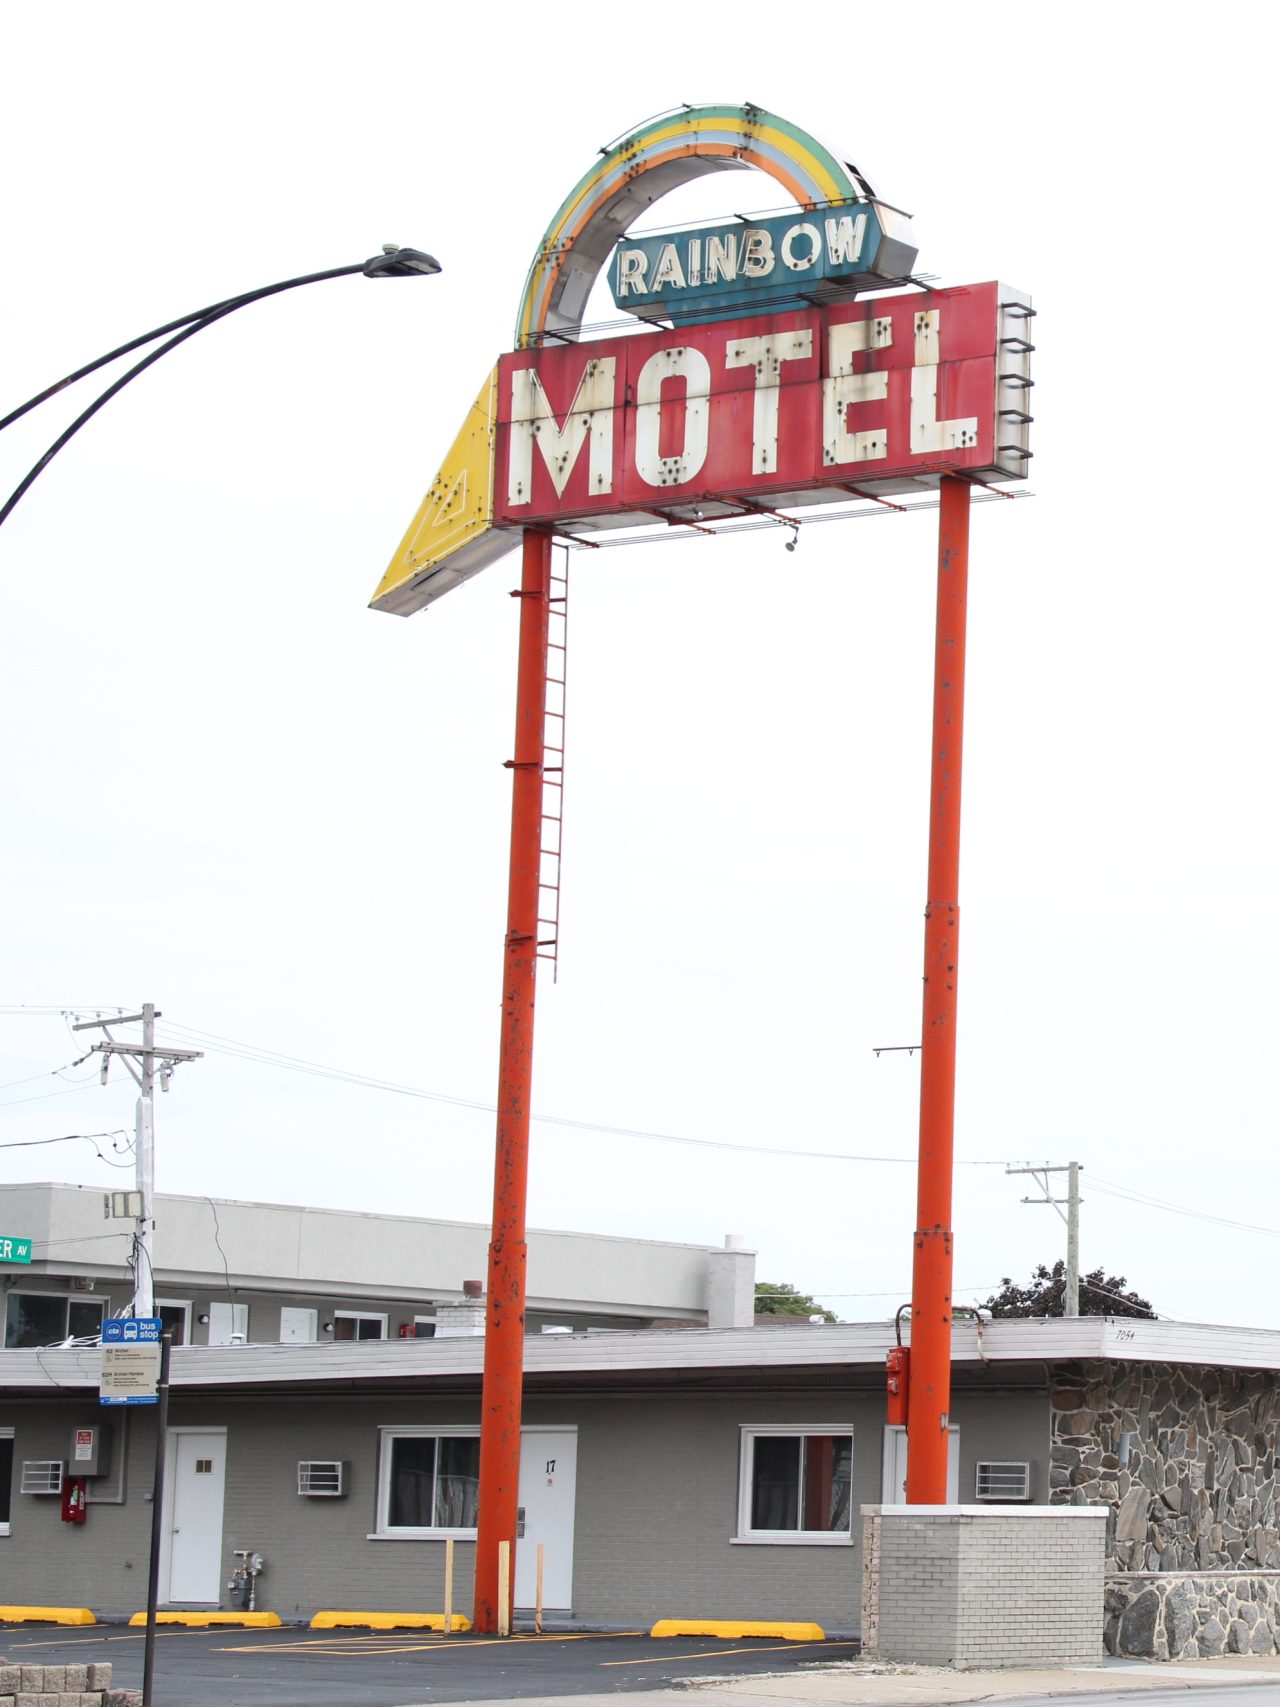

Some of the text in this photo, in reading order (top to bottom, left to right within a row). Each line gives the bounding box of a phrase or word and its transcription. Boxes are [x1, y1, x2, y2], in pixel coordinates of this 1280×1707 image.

[617, 213, 868, 297] RAINBOW
[507, 309, 978, 507] MOTEL
[17, 1245, 27, 1256] AV
[140, 1330, 158, 1340] stop
[546, 1460, 556, 1473] 17
